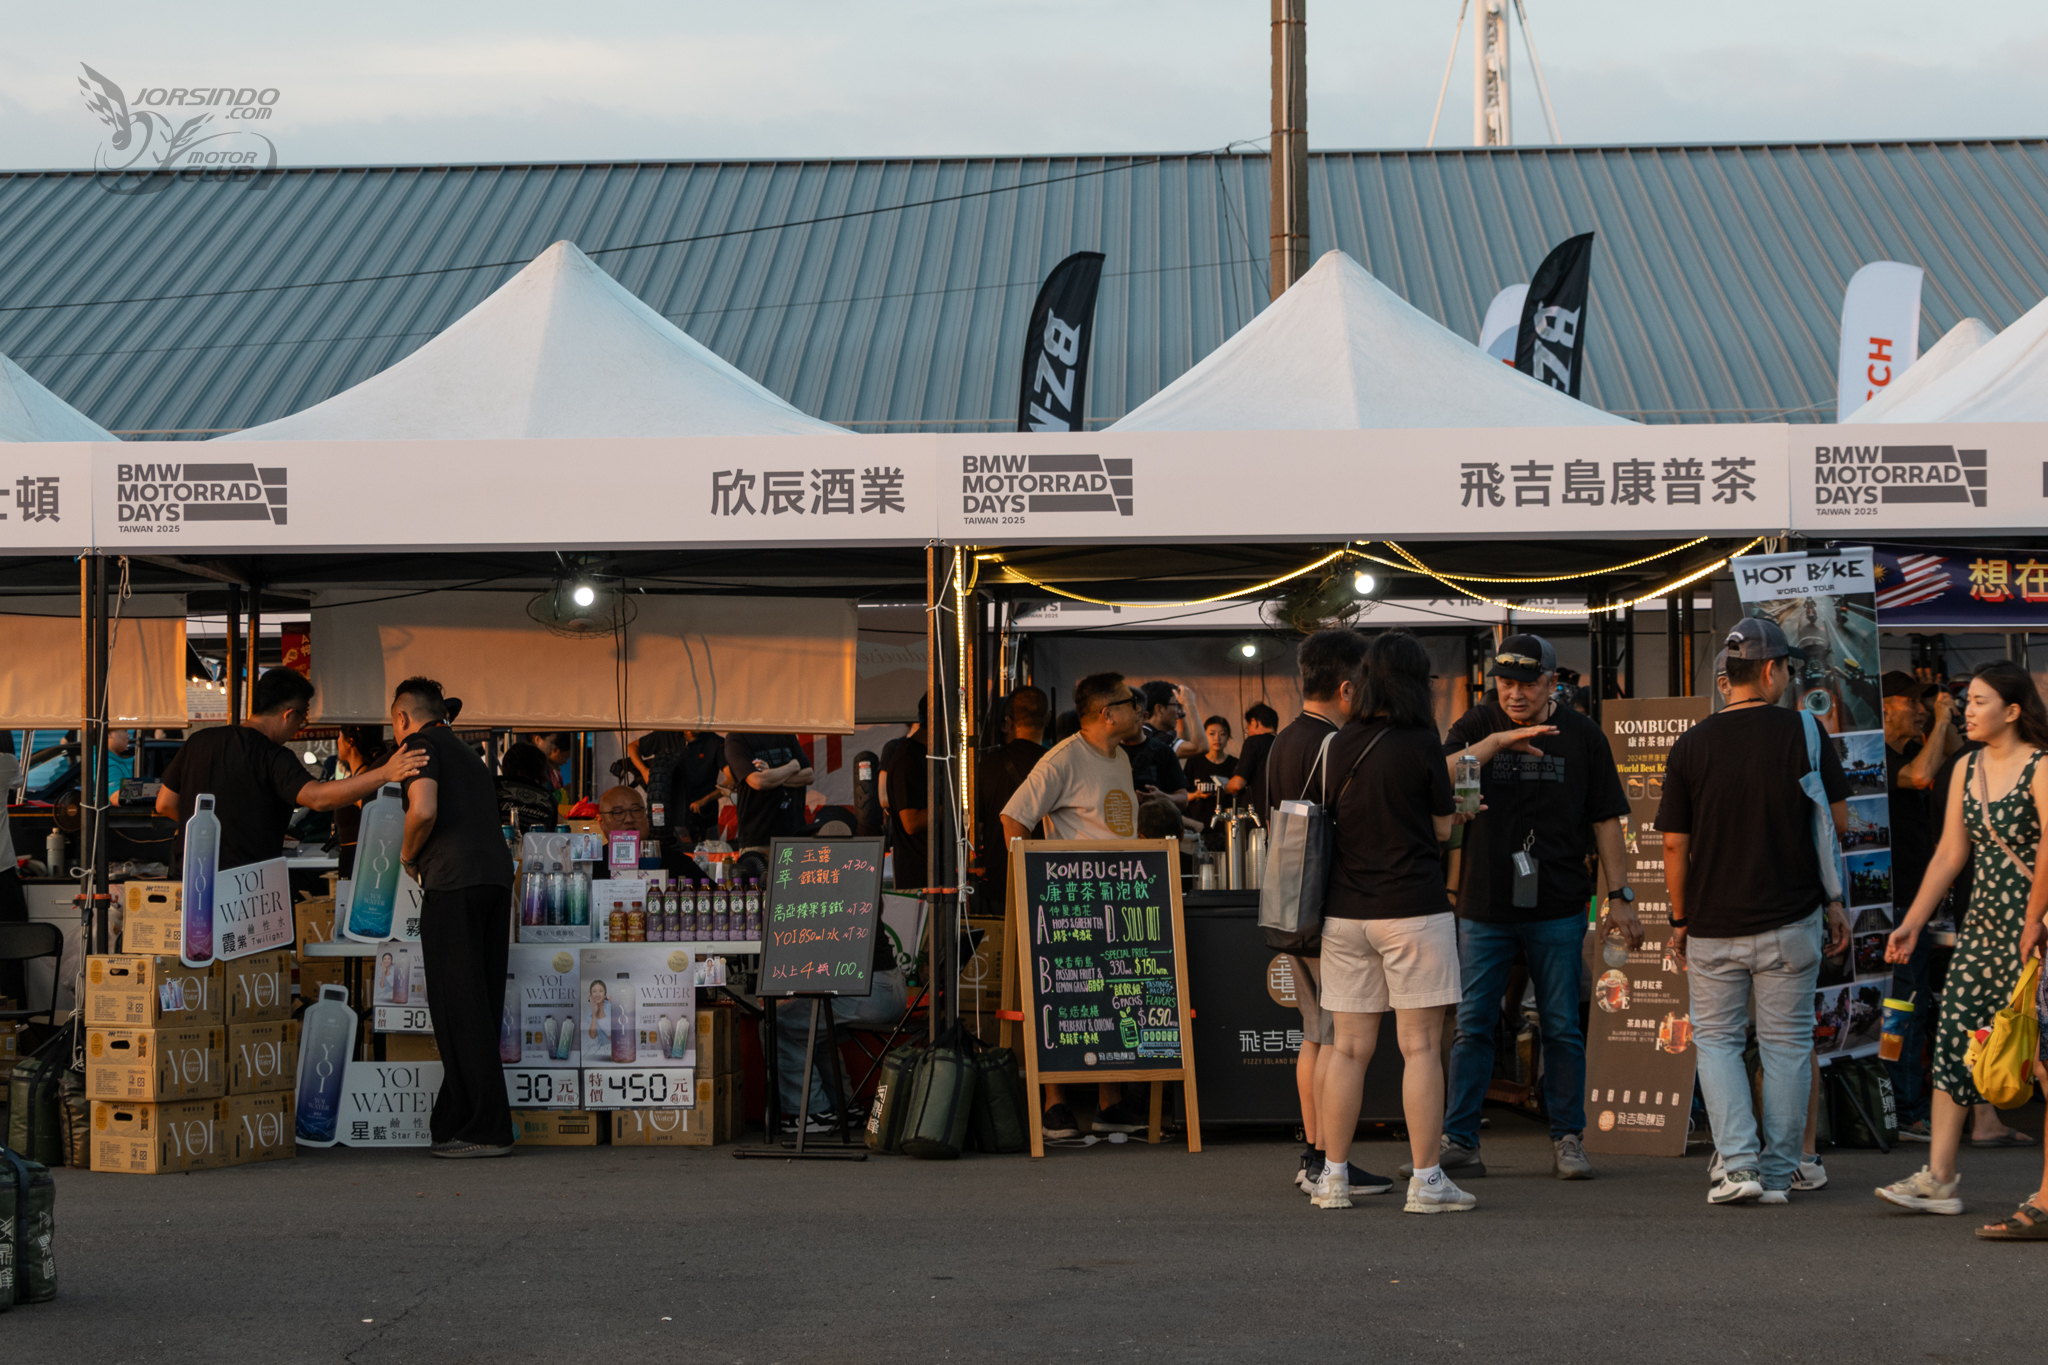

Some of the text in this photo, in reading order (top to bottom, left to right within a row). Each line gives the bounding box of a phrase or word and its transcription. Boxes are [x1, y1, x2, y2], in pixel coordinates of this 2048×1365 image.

[963, 455, 1027, 473] BMW
[1815, 446, 1880, 464] BMW
[117, 464, 182, 482] BMW
[1460, 457, 1757, 508] 飛吉島康普茶
[1815, 465, 1961, 485] MOTORRAD
[117, 483, 262, 502] MOTORRAD
[710, 466, 906, 517] 欣辰酒業
[963, 474, 1108, 493] MOTORRAD
[963, 495, 1026, 513] DAYS
[1815, 486, 1878, 504] DAYS
[118, 503, 180, 522] DAYS
[1002, 516, 1026, 524] 2025
[1816, 507, 1878, 516] TAIWAN 2025
[119, 525, 180, 533] TAIWAN 2025
[1742, 564, 1796, 586] HOT
[1968, 557, 2048, 604] 想在
[1776, 584, 1835, 596] WORLD TOUR
[1492, 763, 1554, 771] MOORRAD
[1616, 763, 1639, 773] World
[1640, 763, 1656, 772] Best
[373, 839, 391, 890] YOI
[194, 857, 207, 911] YOI
[234, 868, 265, 895] YOI
[799, 868, 841, 885] 鐵觀音
[220, 891, 283, 925] WATER
[1121, 906, 1161, 942] SOLD OUT
[251, 931, 284, 946] Twilight
[1662, 958, 1672, 972] D
[538, 975, 563, 986] YOI
[653, 974, 678, 985] YOI
[238, 972, 279, 1008] YOI
[526, 988, 575, 1000] WATER
[640, 987, 690, 999] WATER
[1146, 995, 1177, 1008] FLAVORS
[1621, 996, 1630, 1010] E
[403, 1009, 426, 1029] 30
[1655, 1037, 1665, 1051] F
[167, 1047, 209, 1085] YOI
[240, 1041, 281, 1077] YOI
[316, 1043, 335, 1094] YOI
[376, 1067, 420, 1089] YOI
[558, 1078, 574, 1094] 元
[588, 1072, 604, 1103] 特價
[608, 1073, 667, 1102] 450
[673, 1078, 688, 1094] 元
[516, 1074, 553, 1102] 30
[169, 1119, 214, 1157] YOI
[242, 1112, 283, 1149] YOI
[351, 1121, 387, 1141] 星藍
[391, 1131, 410, 1140] Star
